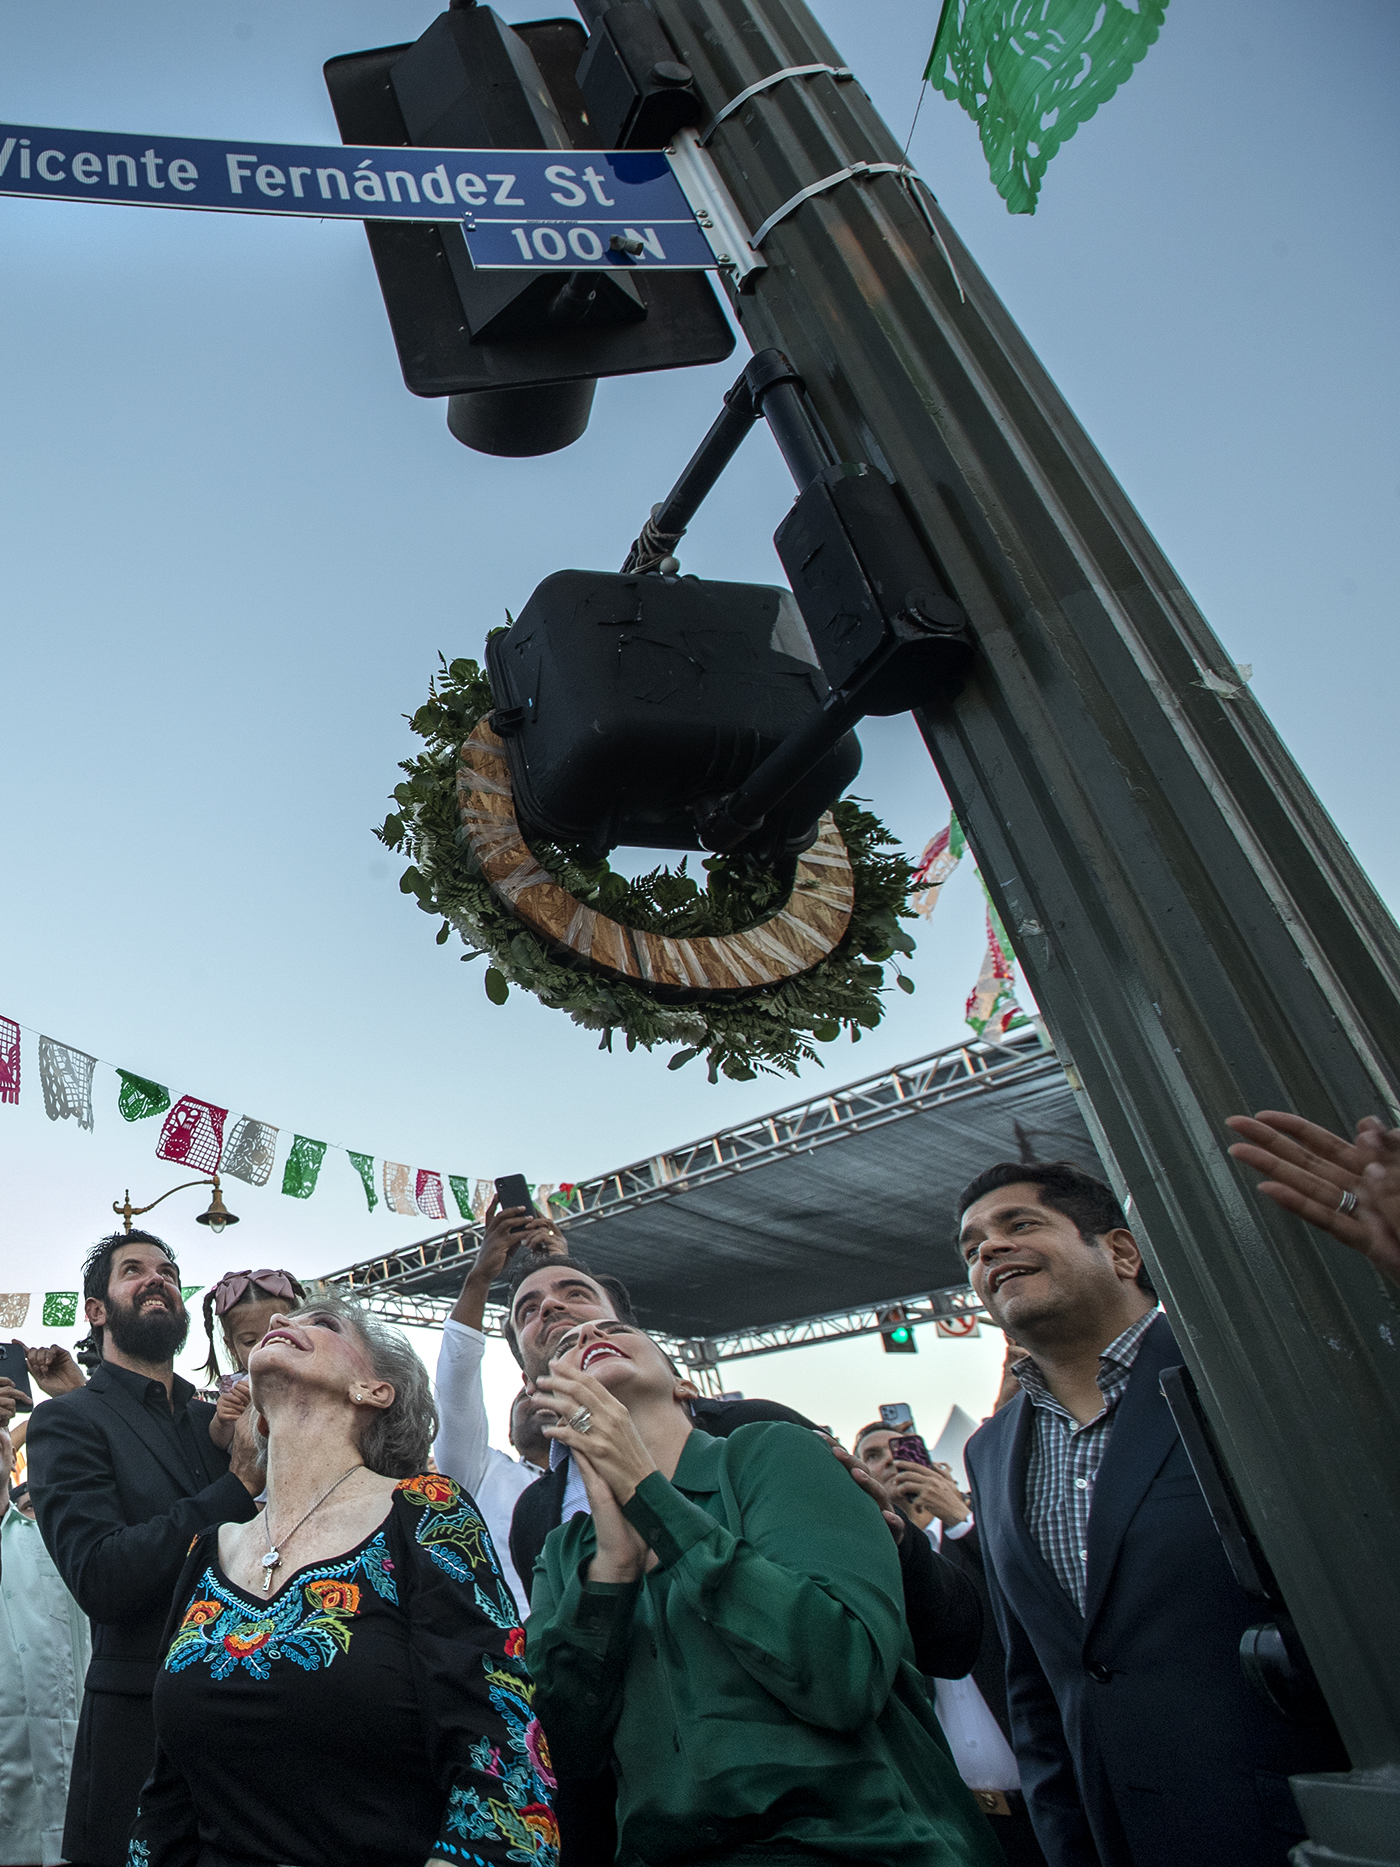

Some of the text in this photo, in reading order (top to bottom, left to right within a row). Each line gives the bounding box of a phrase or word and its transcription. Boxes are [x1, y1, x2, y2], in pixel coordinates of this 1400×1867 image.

[226, 153, 525, 207] Fernández
[544, 164, 616, 208] St
[511, 227, 667, 261] 100 N
